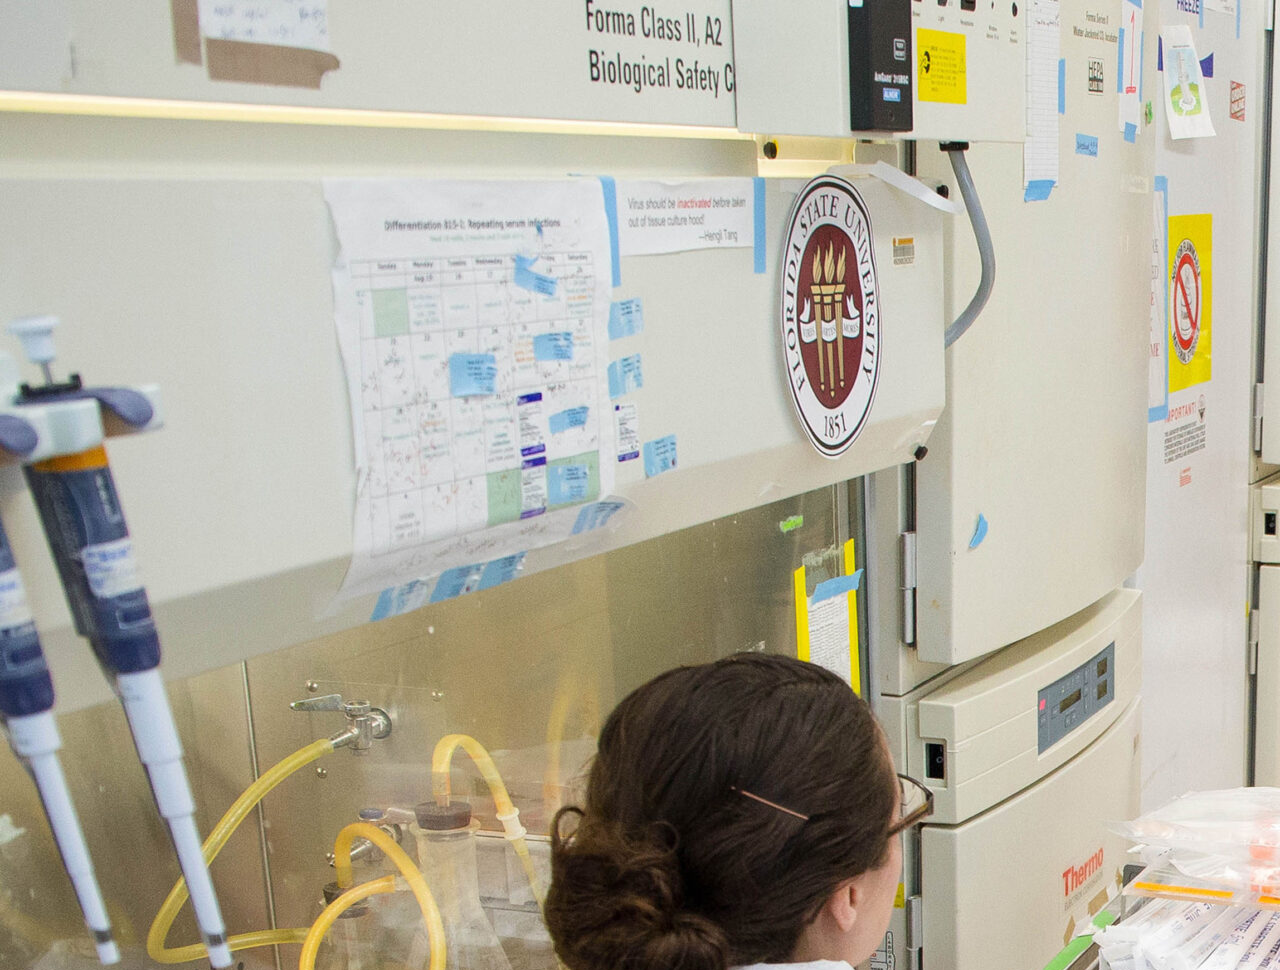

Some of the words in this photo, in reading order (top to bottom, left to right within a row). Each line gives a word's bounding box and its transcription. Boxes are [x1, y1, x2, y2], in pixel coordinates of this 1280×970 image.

[586, 0, 635, 36] Forma
[641, 6, 682, 41] Class
[687, 13, 700, 47] II,
[705, 16, 722, 46] A2
[589, 50, 670, 93] Biological
[675, 58, 719, 98] Safety
[1088, 60, 1103, 78] HEPA
[628, 197, 644, 209] Virus
[646, 197, 666, 209] should
[668, 197, 676, 209] be
[677, 197, 712, 209] inactivated
[713, 197, 731, 208] before
[384, 219, 442, 231] Differentiation
[468, 219, 504, 231] Repeating
[506, 220, 526, 229] serum
[628, 217, 639, 228] out
[640, 215, 647, 227] of
[648, 215, 666, 227] tissue
[667, 214, 687, 226] culture
[723, 229, 738, 242] Tang
[784, 245, 807, 392] FLORIDA
[800, 194, 839, 238] STATE
[844, 203, 877, 384] UNIVERSITY
[824, 411, 848, 438] 1851
[1062, 847, 1104, 897] Thermo
